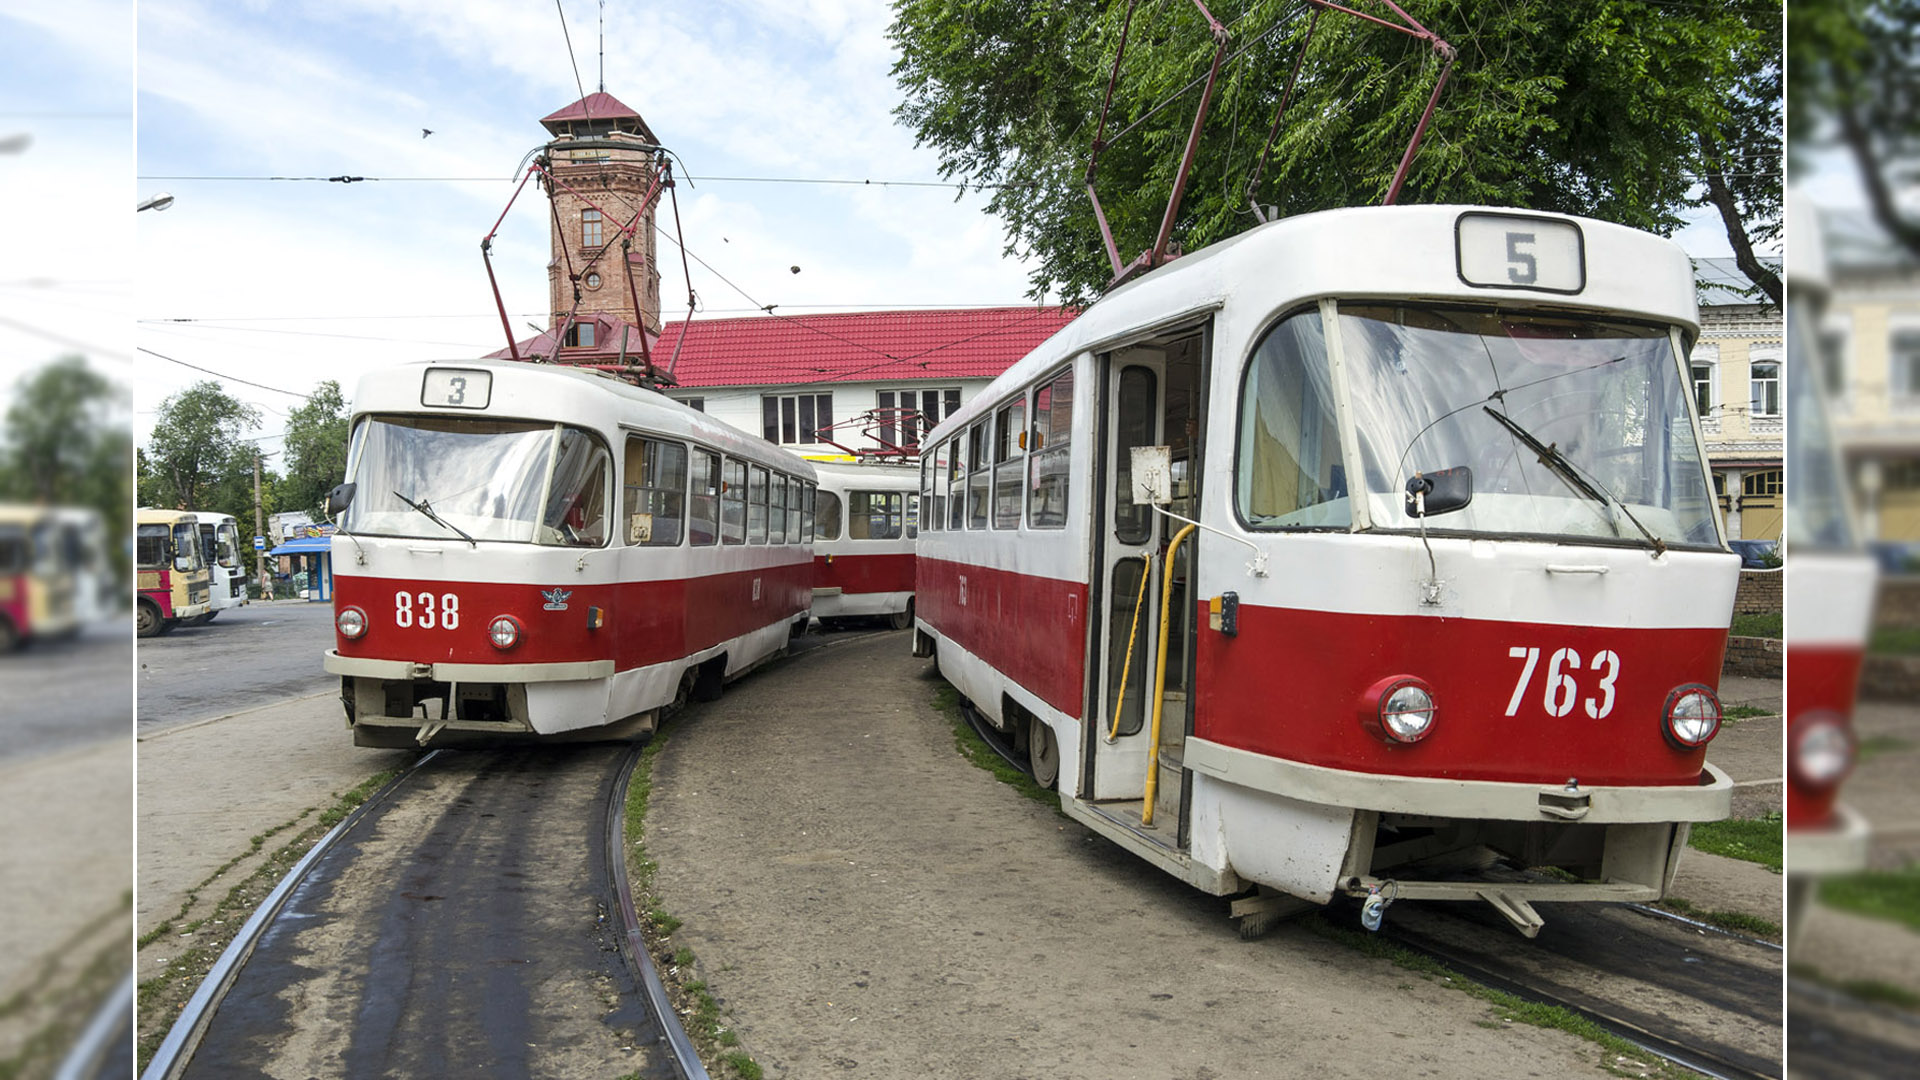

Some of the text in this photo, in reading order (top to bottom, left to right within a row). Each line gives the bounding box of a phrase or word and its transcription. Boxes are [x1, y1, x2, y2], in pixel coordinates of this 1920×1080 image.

[1506, 232, 1537, 284] 5
[448, 377, 467, 404] 3
[395, 591, 459, 631] 838
[1504, 646, 1620, 719] 763
